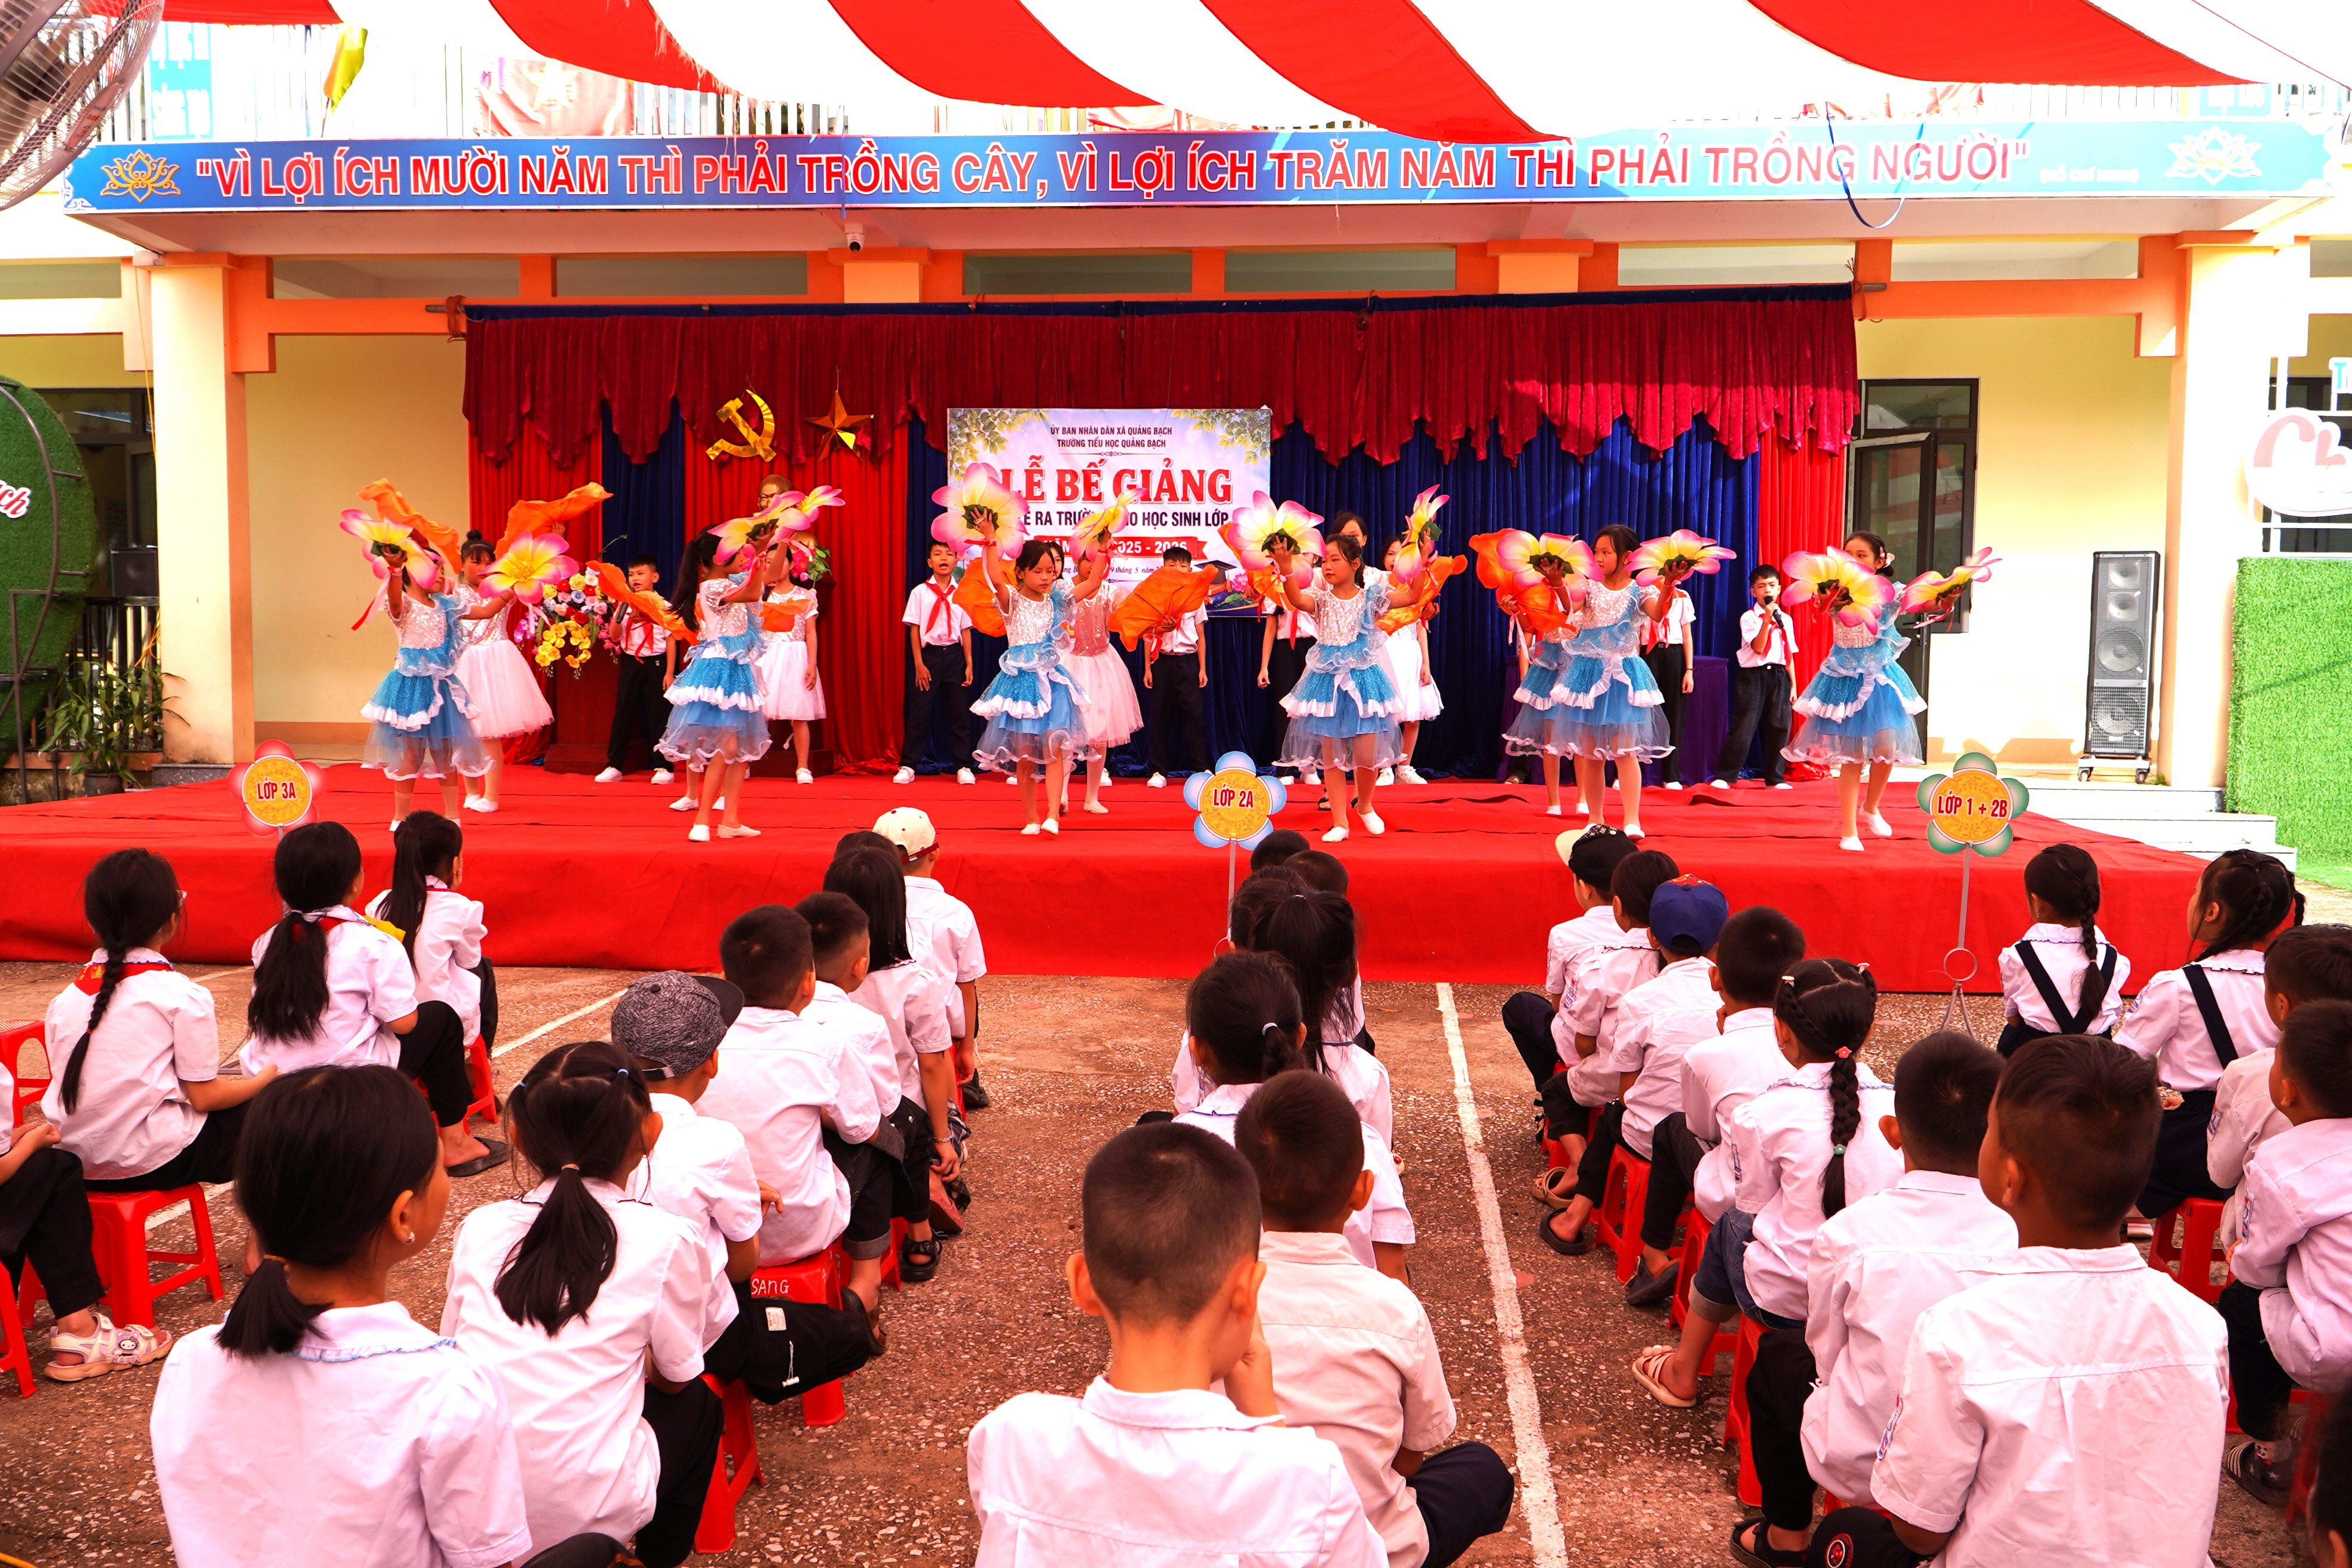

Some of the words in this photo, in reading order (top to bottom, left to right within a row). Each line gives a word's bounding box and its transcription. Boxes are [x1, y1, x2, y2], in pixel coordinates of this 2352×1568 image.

[197, 148, 251, 197] "VÌ
[262, 152, 323, 204] LỢI
[334, 147, 400, 196] ÍCH
[411, 146, 508, 195] MƯỜI
[519, 146, 608, 194] NĂM
[618, 145, 683, 194] THÌ
[694, 139, 788, 194] PHẢI
[797, 139, 940, 194] TRỒNG
[953, 142, 1048, 200] CÂY,
[1056, 140, 1098, 191] VÌ
[1109, 146, 1175, 200] LỢI
[1187, 140, 1256, 192] ÍCH
[1267, 139, 1389, 189] TRĂM
[1401, 140, 1496, 189] NĂM
[1508, 139, 1576, 187] THÌ
[1589, 132, 1690, 186] PHẢI
[1704, 130, 1855, 184] TRỒNG
[1871, 131, 2028, 182] NGƯỜI"
[1051, 424, 1059, 434] ỦY
[1079, 425, 1098, 434] NHÂN
[1101, 425, 1114, 434] DÂN
[1117, 425, 1126, 434] XÃ
[1128, 424, 1152, 436] QUẢNG
[1153, 427, 1172, 437] BẠCH
[1057, 437, 1085, 447] TRƯỜNG
[1088, 436, 1102, 447] TIỂU
[1105, 439, 1119, 449] HỌC
[1121, 437, 1145, 448] QUẢNG
[1147, 439, 1166, 449] BẠCH
[1055, 458, 1107, 501] BẾ
[1113, 457, 1231, 503] GIẢNG
[0, 484, 27, 515] ch
[1035, 511, 1053, 525] RA
[1142, 512, 1168, 529] HỌC
[1171, 512, 1200, 526] SINH
[1205, 509, 1229, 526] LỚP
[257, 777, 277, 800] LỚP
[281, 782, 296, 799] 3A
[1214, 783, 1235, 807] LỚP
[1239, 791, 1254, 808] 2A
[1938, 791, 1962, 814] LỚP
[1967, 798, 1972, 815] 1
[1991, 800, 2008, 817] 2B
